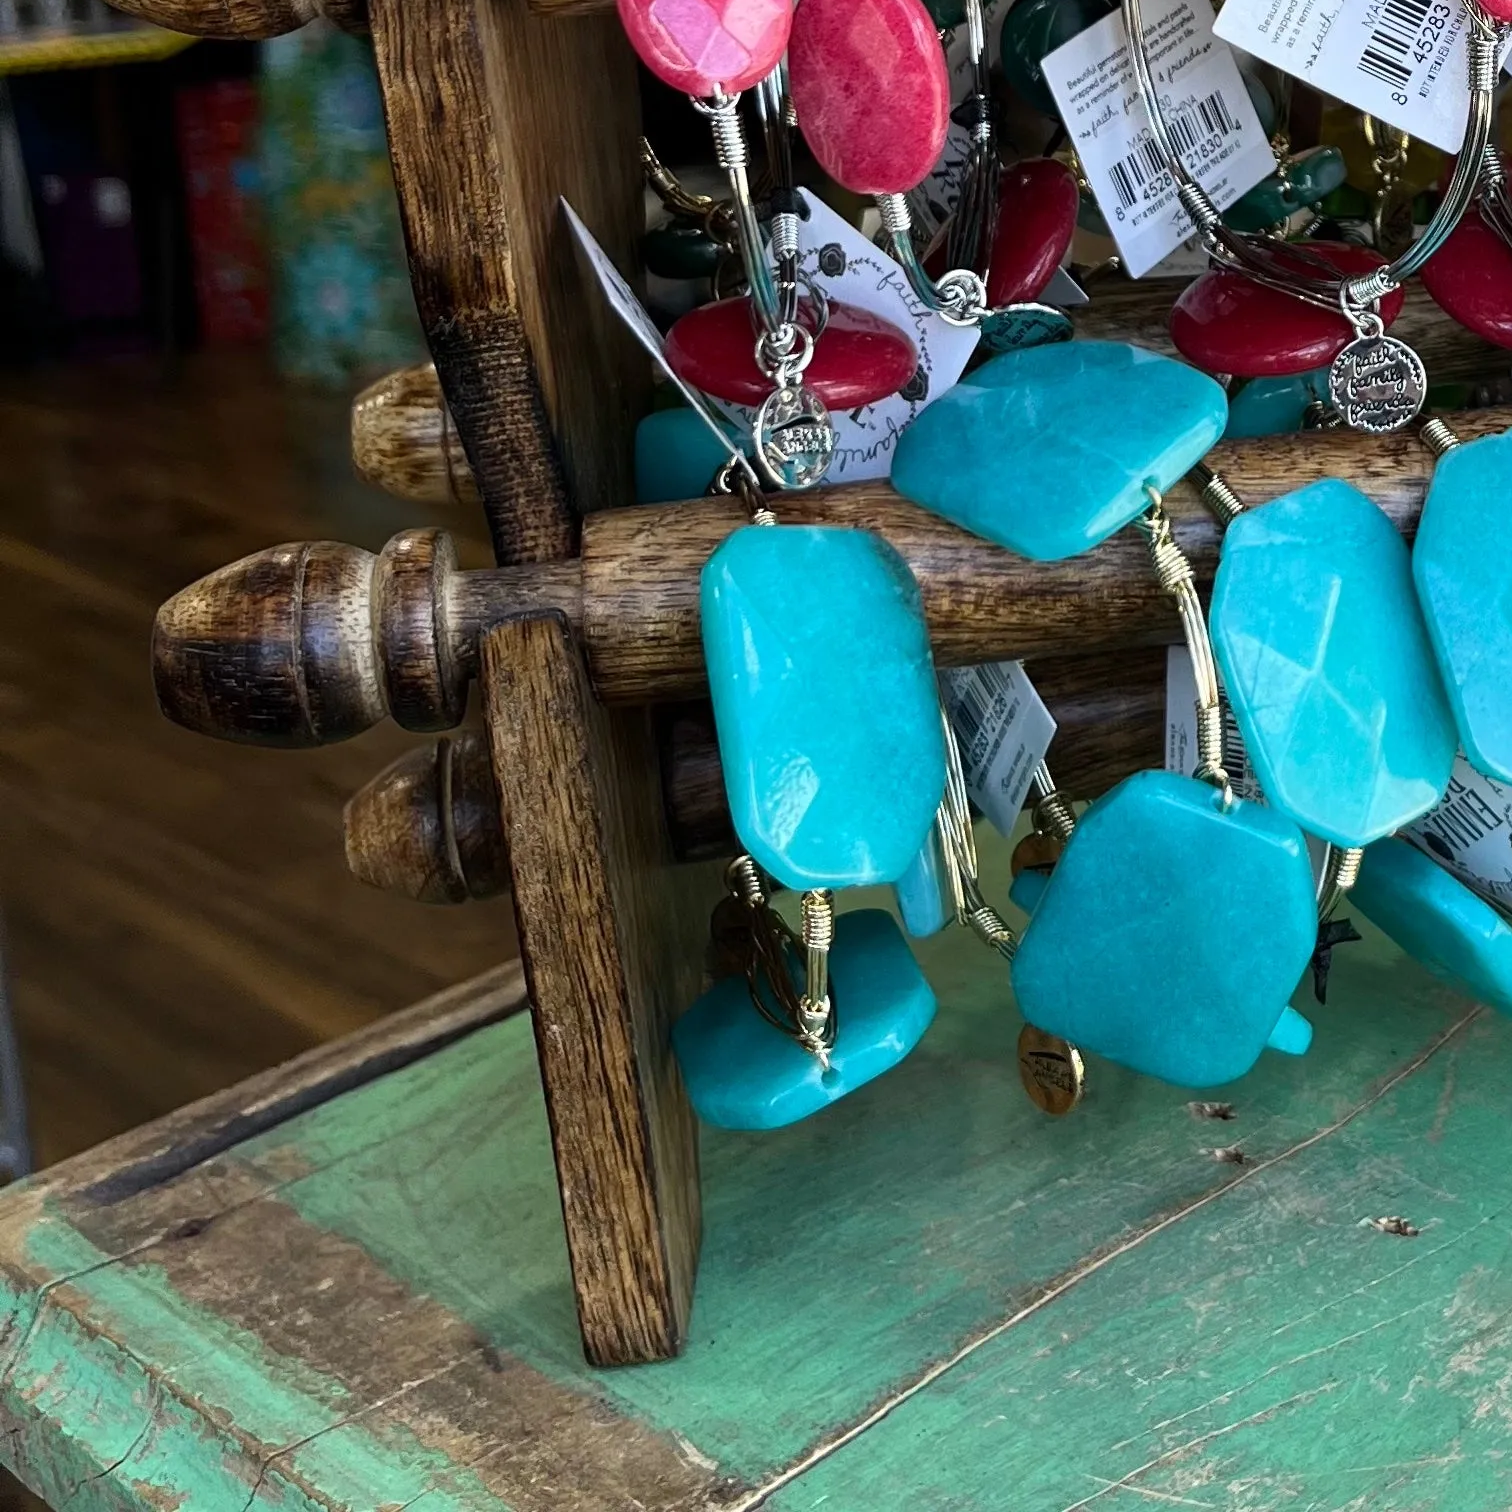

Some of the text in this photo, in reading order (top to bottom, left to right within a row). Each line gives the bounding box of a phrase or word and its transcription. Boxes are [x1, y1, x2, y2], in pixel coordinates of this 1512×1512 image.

[1285, 34, 1296, 48] as
[1389, 1, 1452, 105] 8 45283
[1417, 79, 1432, 98] NOT
[1114, 116, 1243, 222] 8 21830 4
